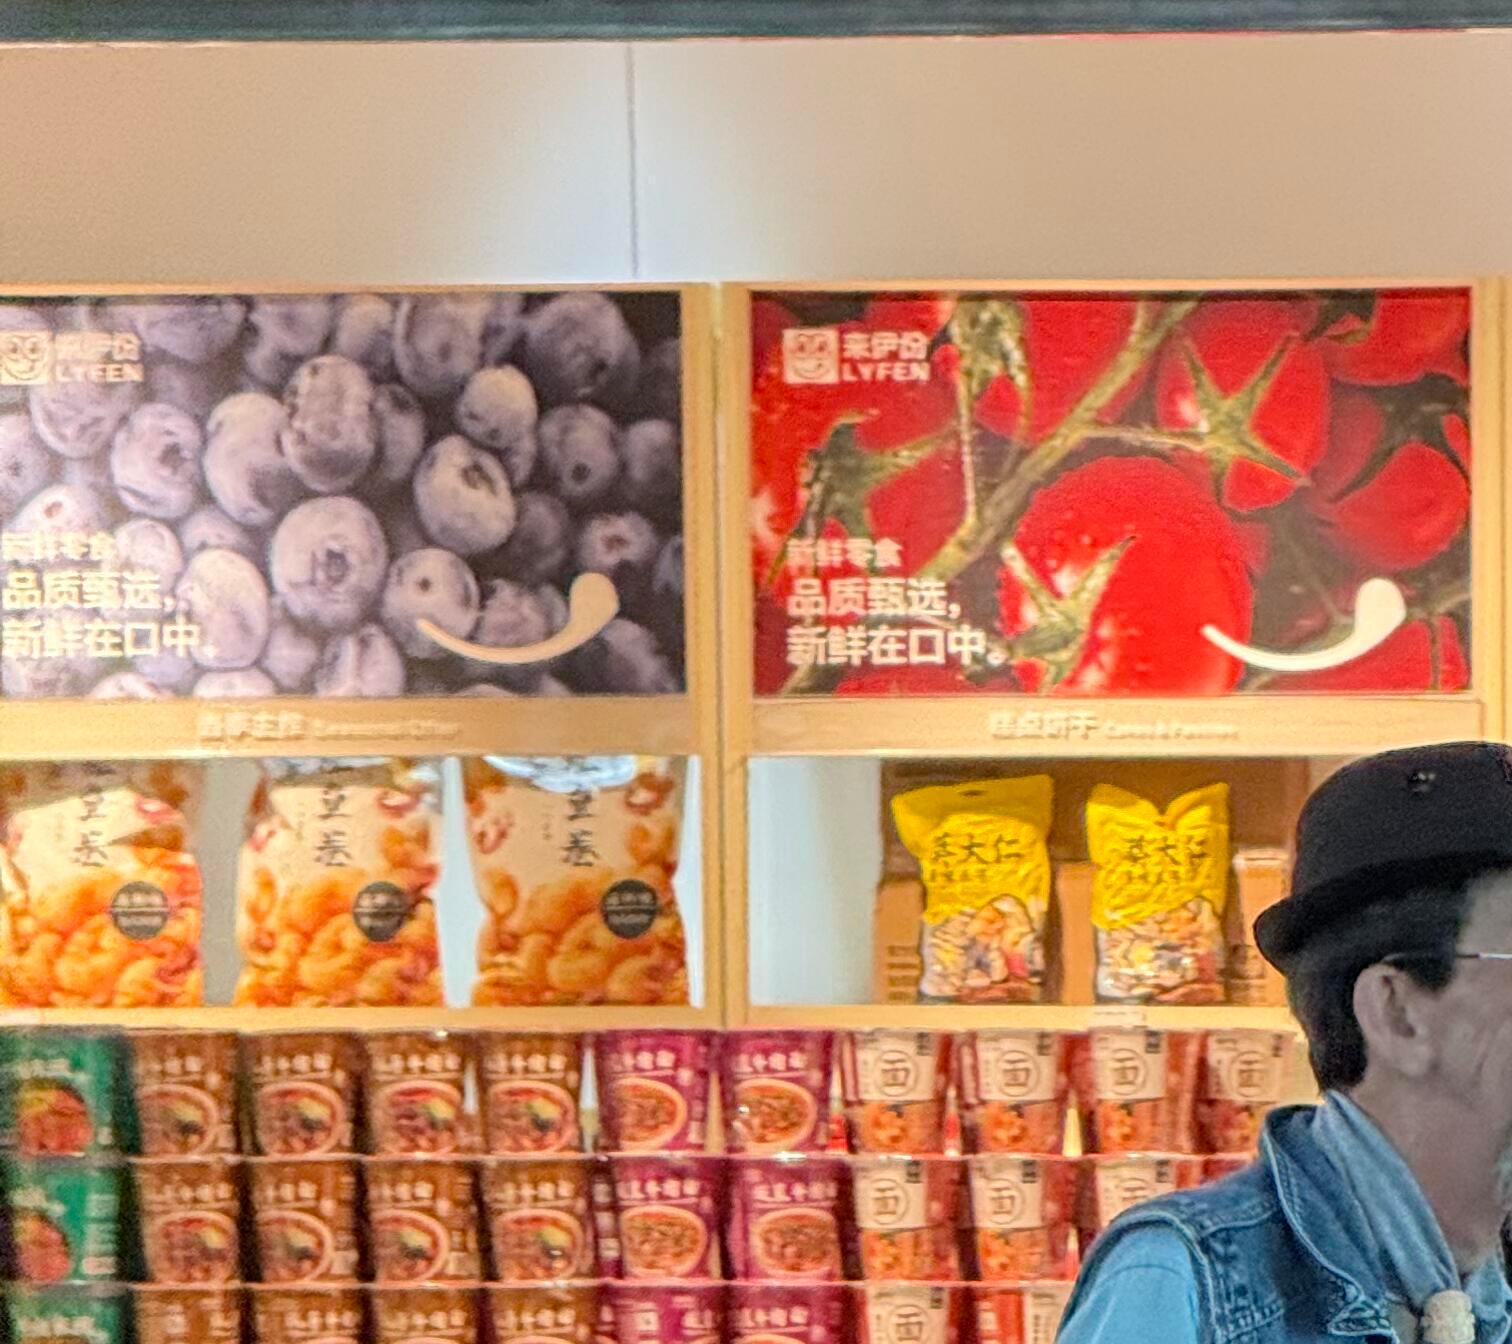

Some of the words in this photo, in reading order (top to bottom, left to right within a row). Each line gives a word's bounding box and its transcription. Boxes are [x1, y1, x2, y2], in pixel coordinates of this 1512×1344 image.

[842, 362, 931, 382] LYFEN
[786, 623, 1009, 667] 新鲜在口中。
